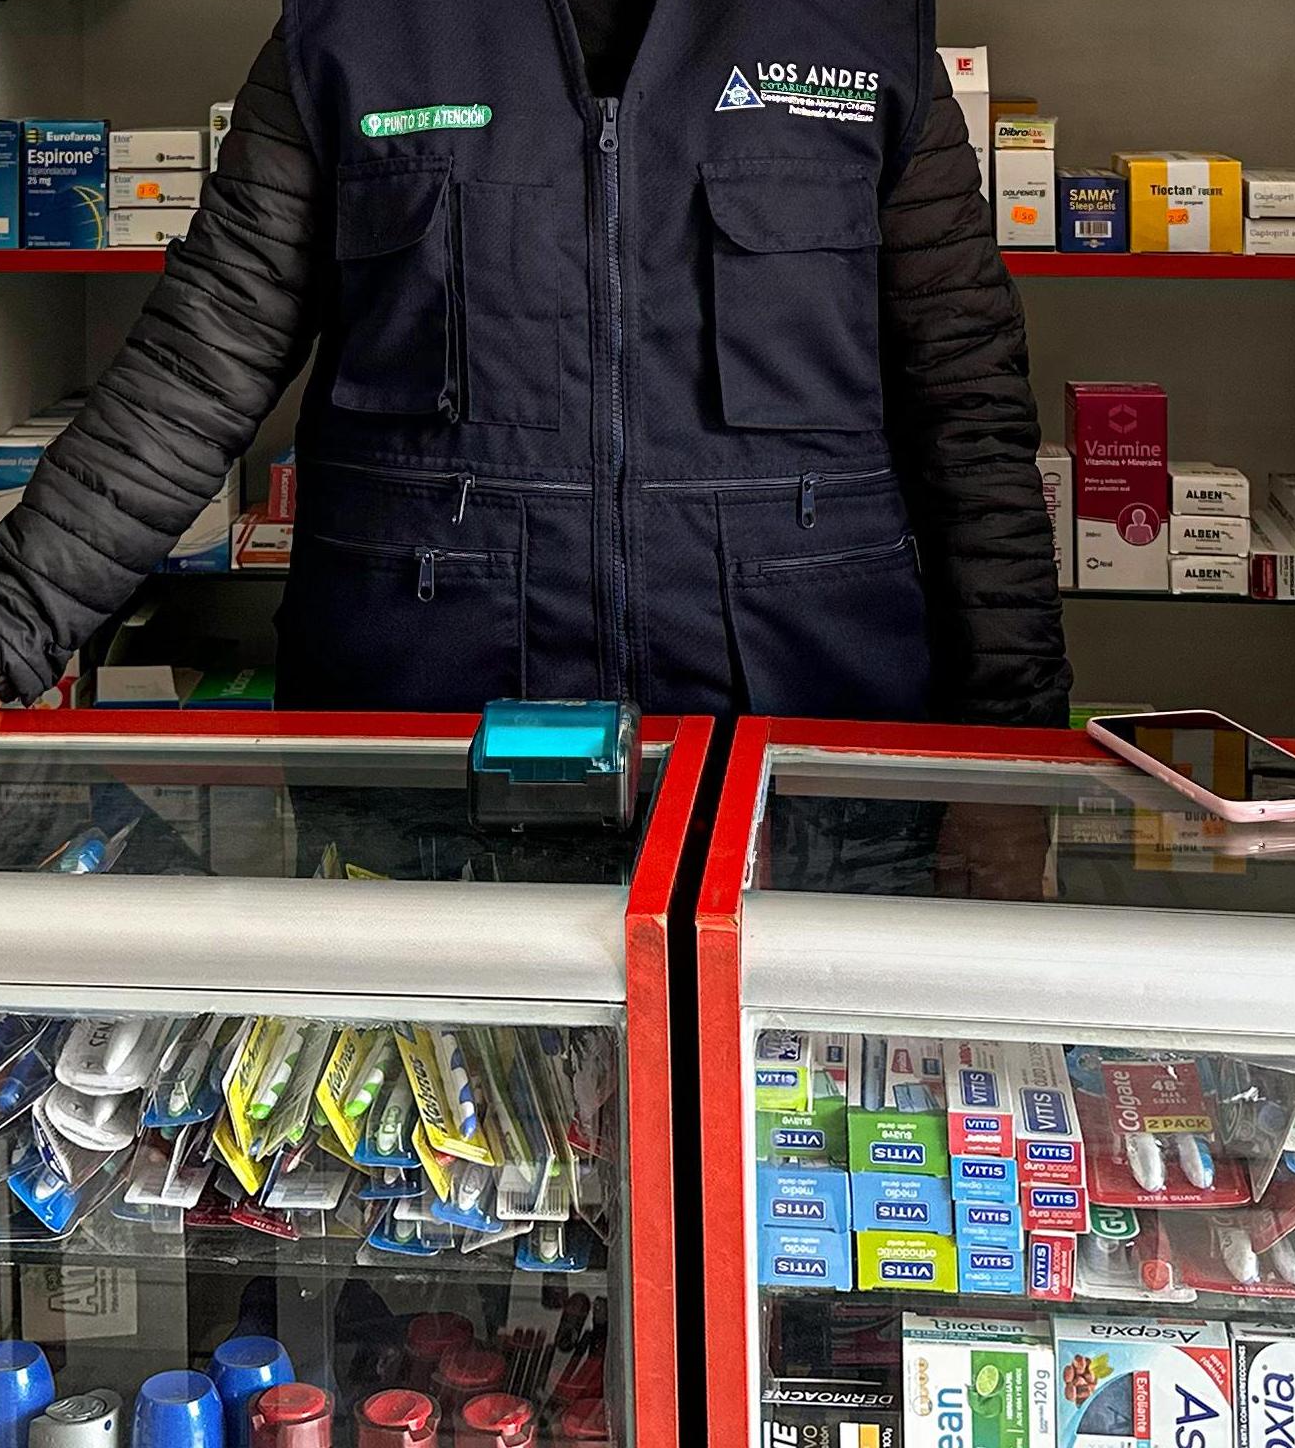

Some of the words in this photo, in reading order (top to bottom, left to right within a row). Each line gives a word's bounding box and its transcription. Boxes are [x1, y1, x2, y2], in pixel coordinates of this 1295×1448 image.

[756, 61, 798, 85] LOS
[805, 65, 880, 92] ANDES
[383, 112, 415, 133] PUNTO
[418, 111, 431, 128] DE
[434, 102, 485, 127] ATENCIÓN
[26, 149, 94, 167] Espirone
[1069, 187, 1116, 204] SAMAY
[1084, 439, 1162, 458] Varimine
[1185, 489, 1223, 501] ALBEN
[1116, 1069, 1142, 1133] Colgate
[964, 1118, 1000, 1131] VITIS
[1146, 1118, 1156, 1130] 2
[1158, 1116, 1207, 1130] PACK
[962, 1163, 1006, 1178] VITIS
[967, 1209, 1011, 1224] VITIS
[972, 1254, 1013, 1269] VITIS
[930, 1318, 1025, 1335] Bioclean
[1090, 1323, 1201, 1343] Asepxia
[1136, 1376, 1149, 1433] Exfoliante
